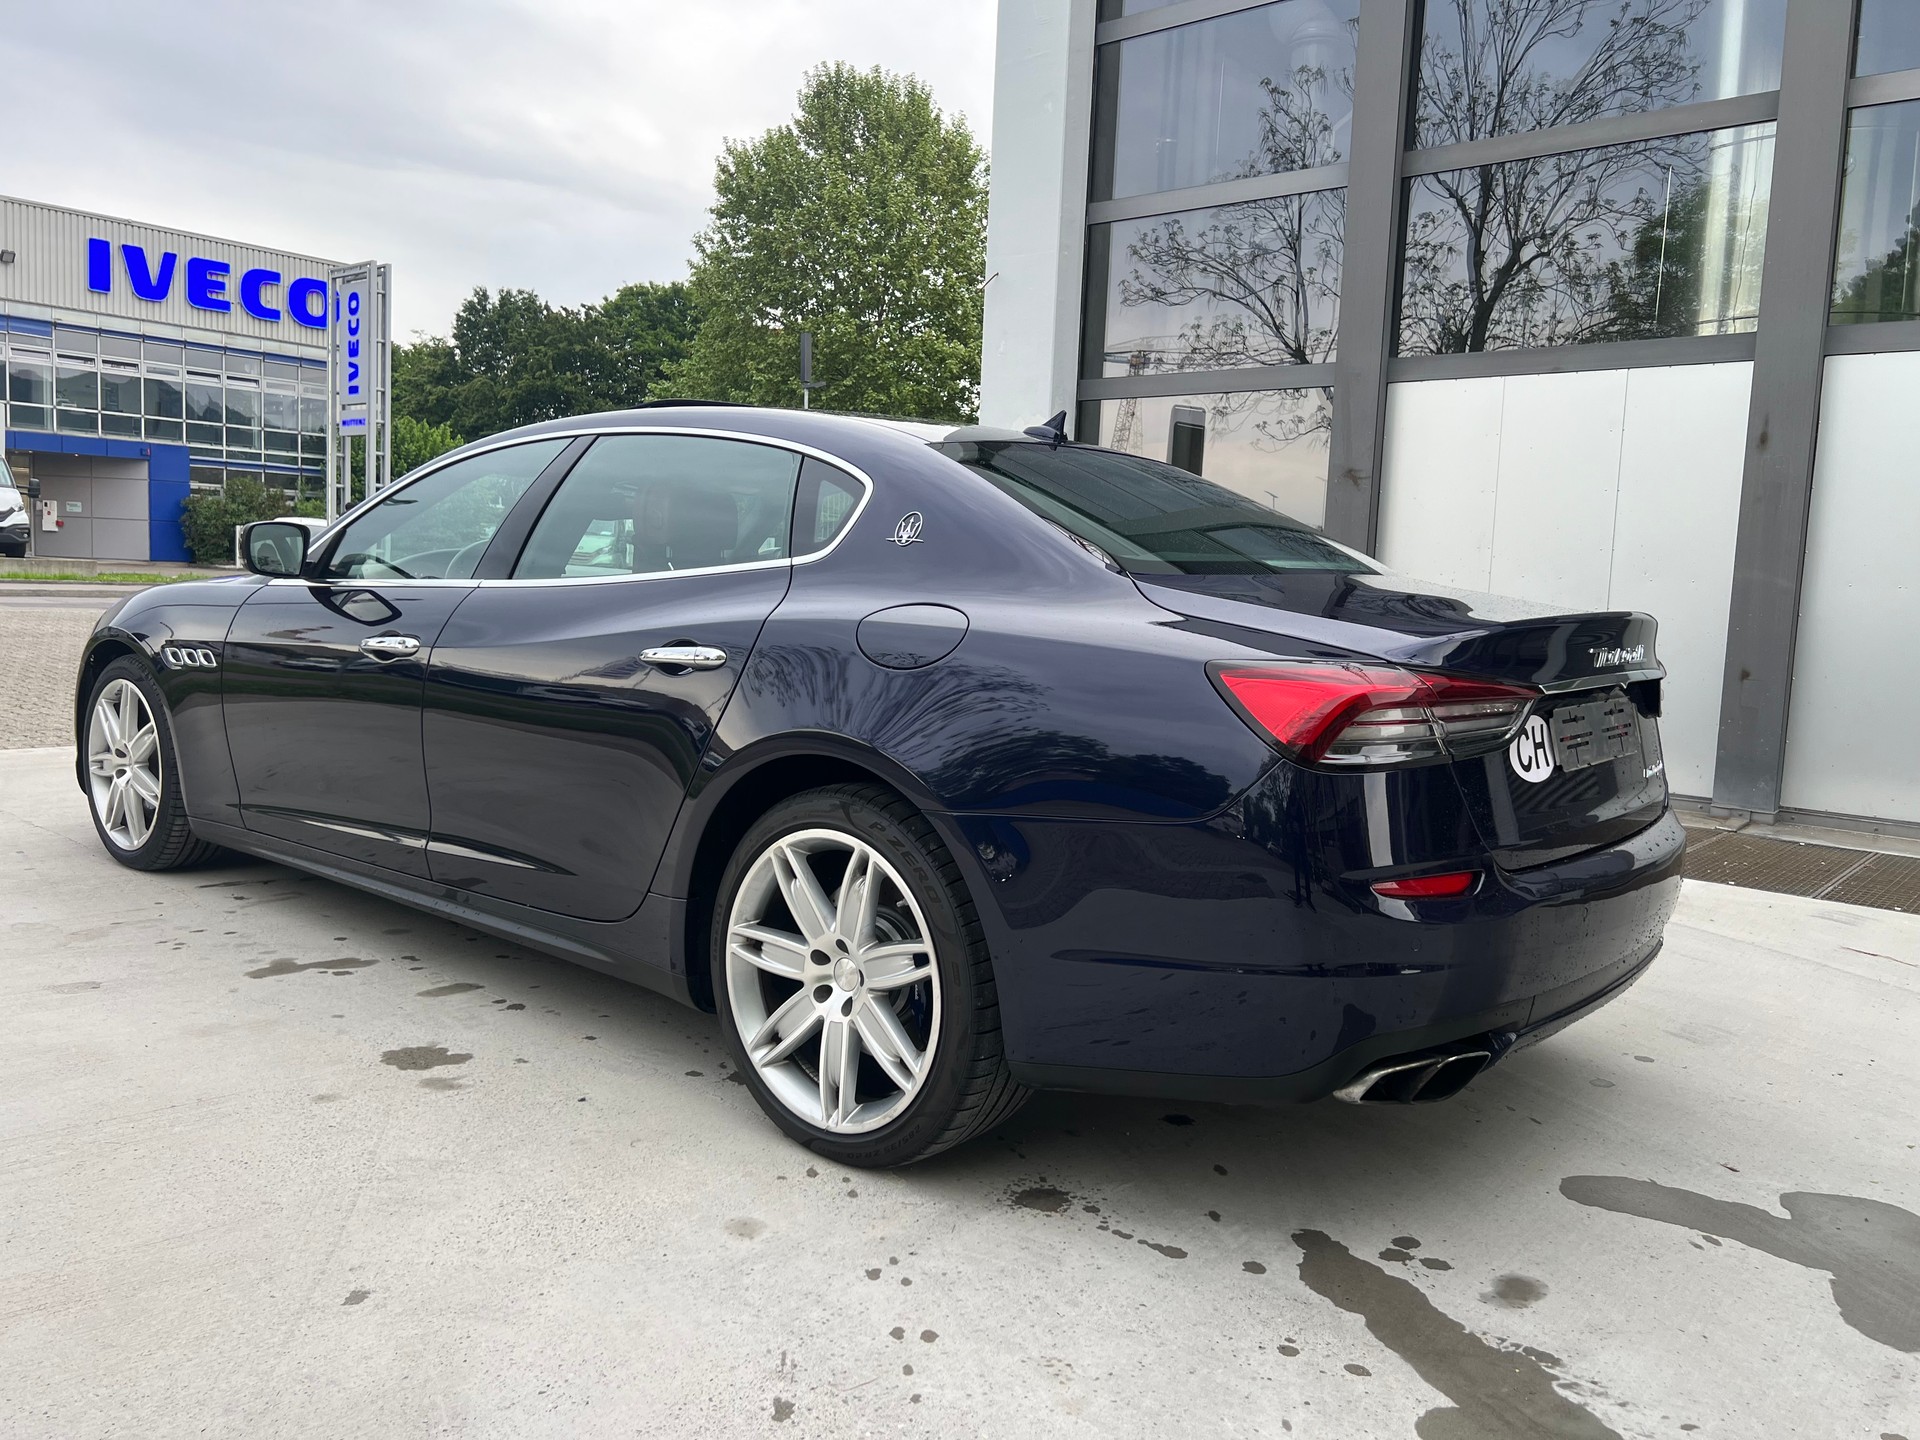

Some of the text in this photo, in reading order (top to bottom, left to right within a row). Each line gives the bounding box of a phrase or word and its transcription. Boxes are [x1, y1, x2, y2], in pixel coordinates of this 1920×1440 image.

[88, 237, 340, 329] IVECO
[347, 291, 360, 395] IVECO
[341, 418, 367, 427] MUTTENZ
[1516, 723, 1551, 773] CH
[868, 821, 942, 904] P ZERO
